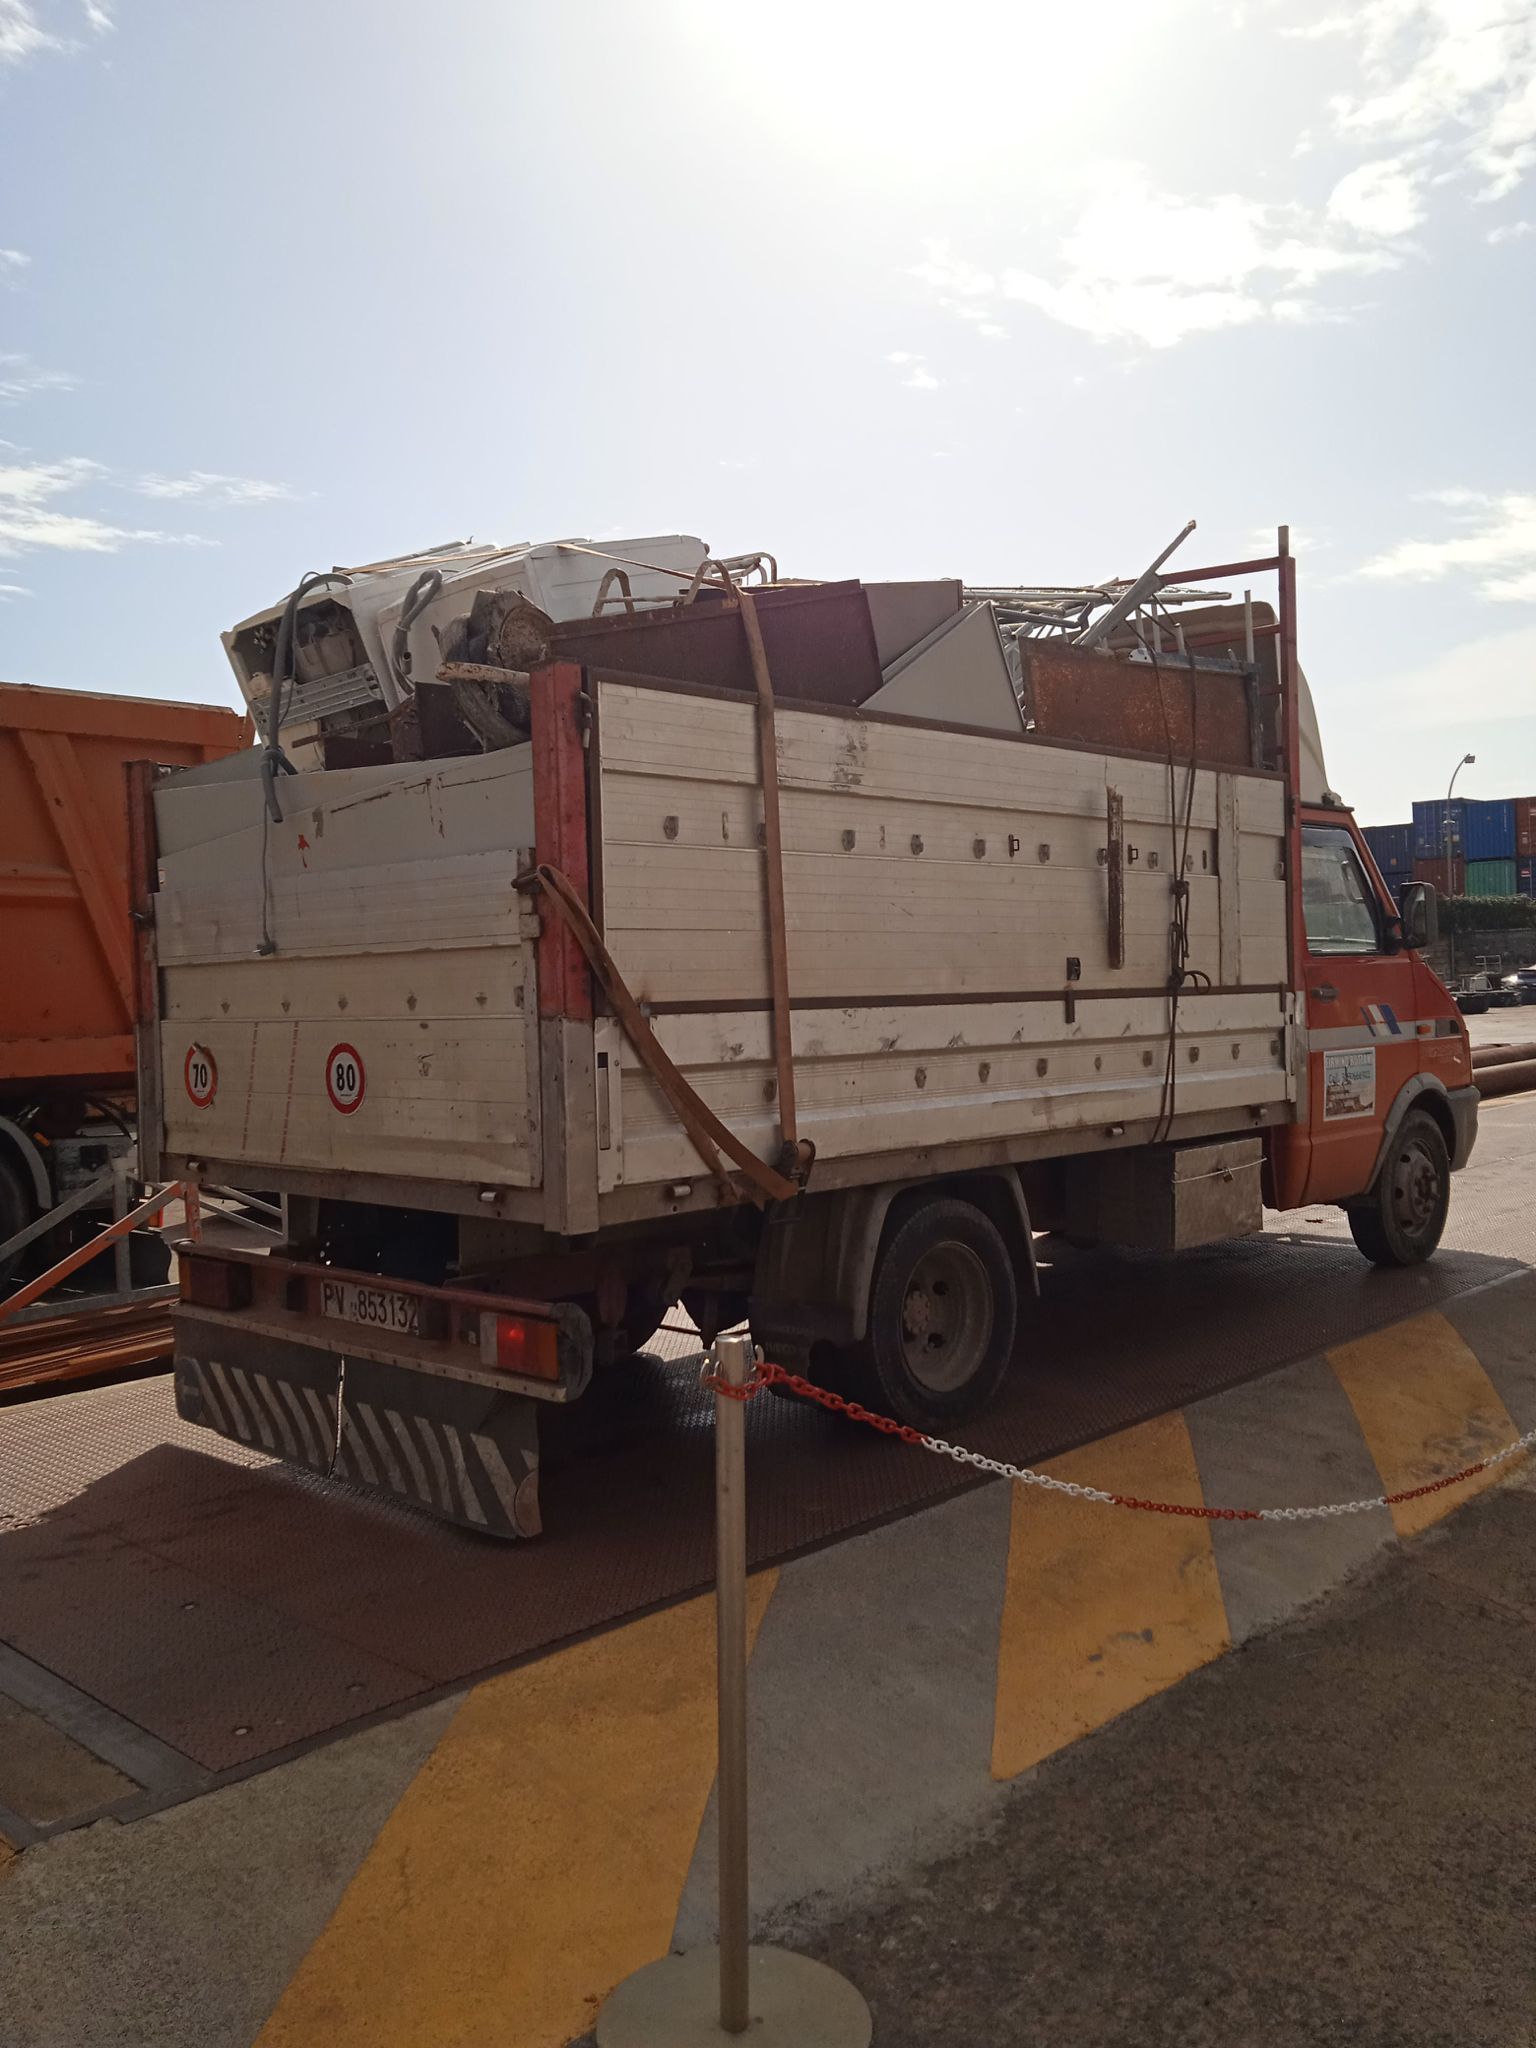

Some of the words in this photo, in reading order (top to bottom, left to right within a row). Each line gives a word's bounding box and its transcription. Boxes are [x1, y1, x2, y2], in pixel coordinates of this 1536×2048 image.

[193, 1064, 208, 1089] 70
[336, 1063, 356, 1092] 80
[323, 1284, 344, 1315] PV
[358, 1289, 419, 1330] 853132
